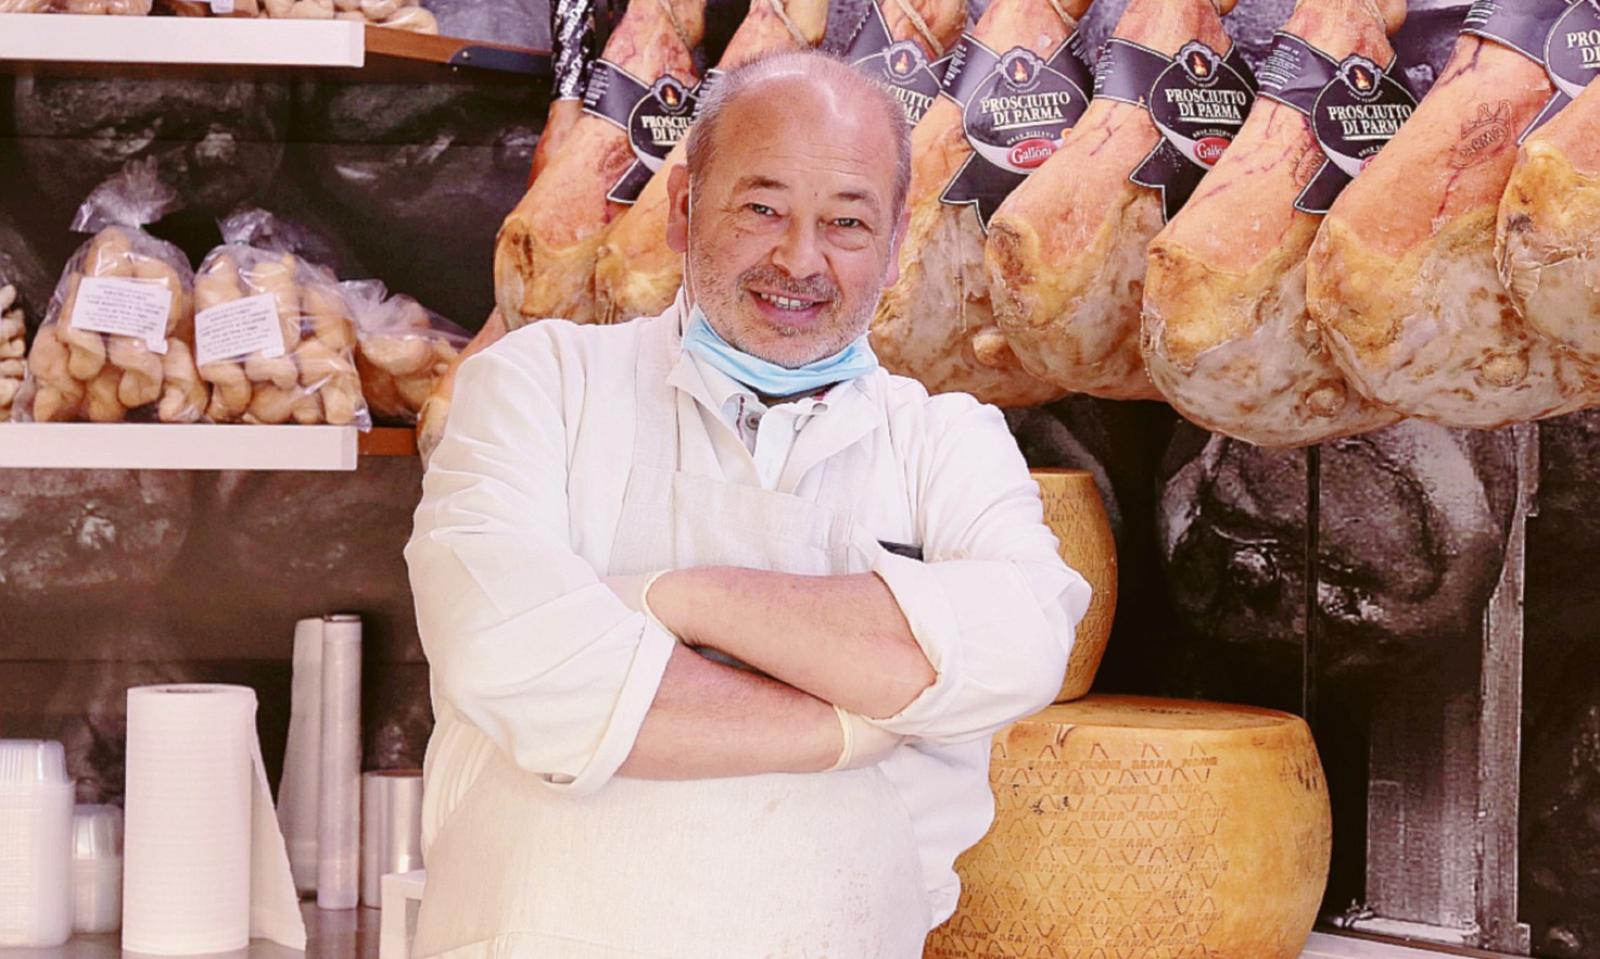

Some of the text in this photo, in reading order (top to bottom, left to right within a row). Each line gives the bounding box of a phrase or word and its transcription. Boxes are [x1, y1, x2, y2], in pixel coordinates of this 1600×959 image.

[981, 91, 1071, 114] PROSCIUTTO
[1164, 88, 1247, 106] PROSCIUTTO
[993, 106, 1064, 125] DI PARMA
[1178, 102, 1242, 119] DI PARMA
[1327, 104, 1412, 121] PROSCIUTTO
[652, 128, 667, 141] DI
[1341, 119, 1404, 136] DI PARM
